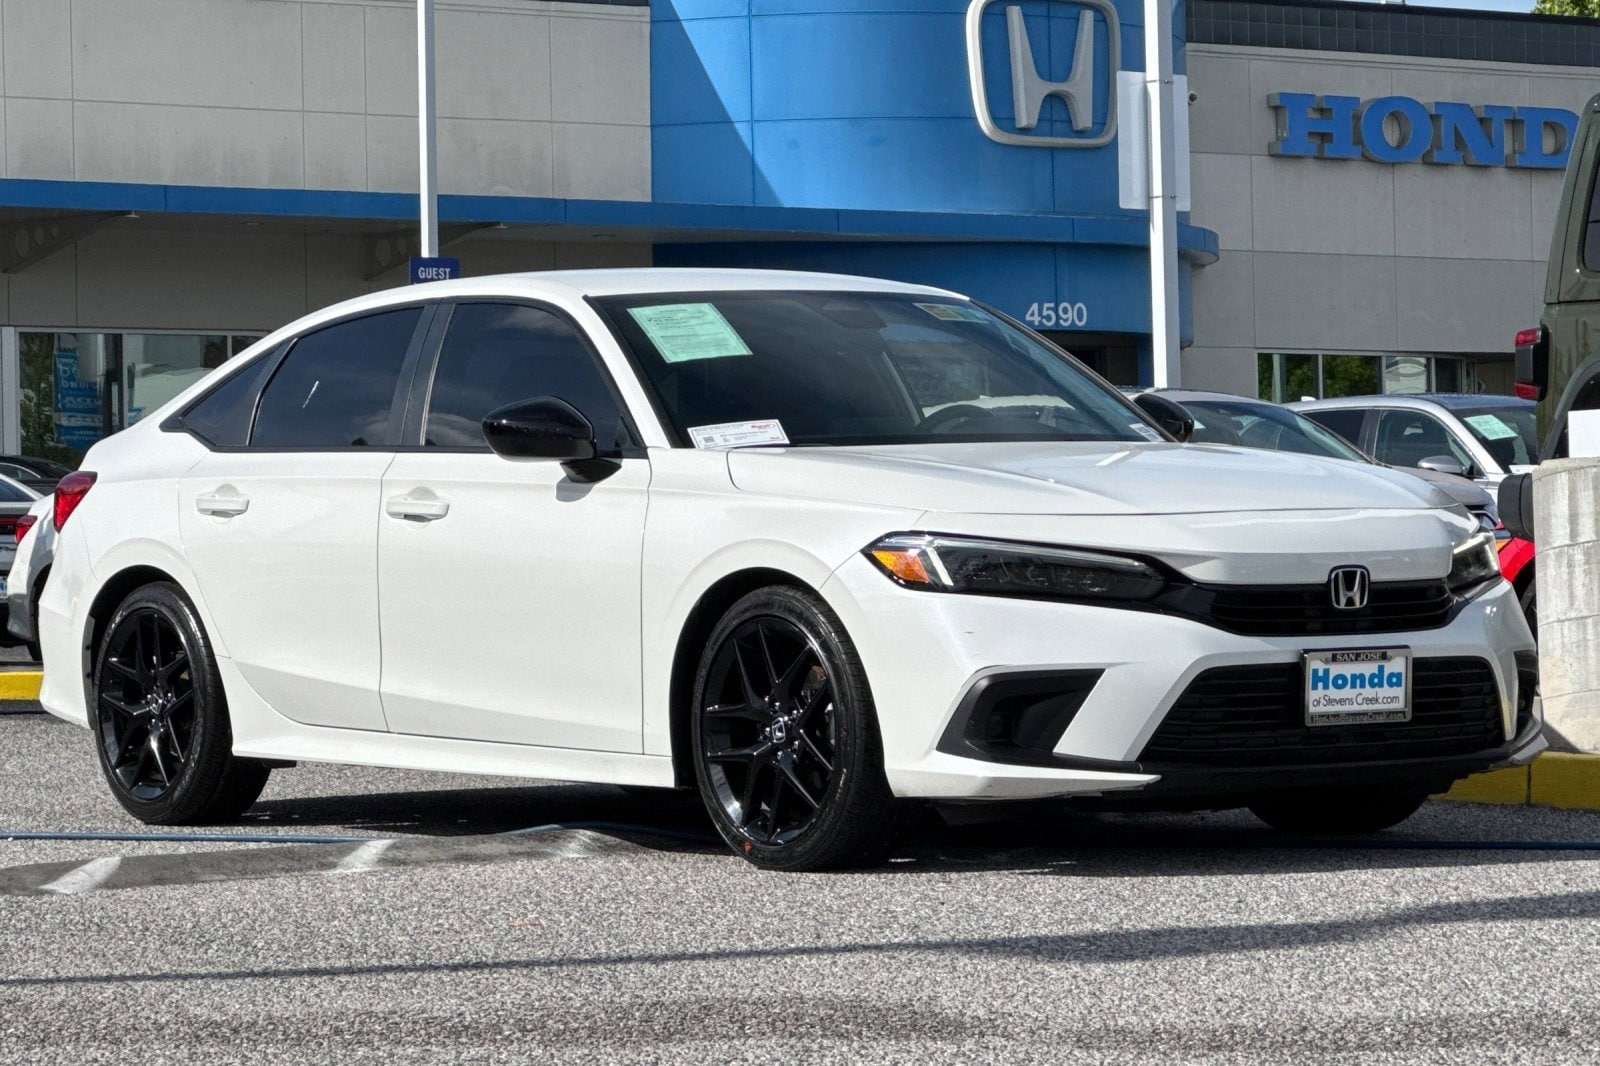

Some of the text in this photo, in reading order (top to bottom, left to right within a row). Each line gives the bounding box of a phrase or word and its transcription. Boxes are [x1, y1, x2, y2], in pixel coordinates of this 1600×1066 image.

[418, 267, 451, 280] GUEST
[1025, 302, 1087, 326] 4590
[1336, 652, 1383, 662] SAN JOSE
[1311, 664, 1403, 691] Honda
[1312, 691, 1400, 707] of Stevens Creek.com
